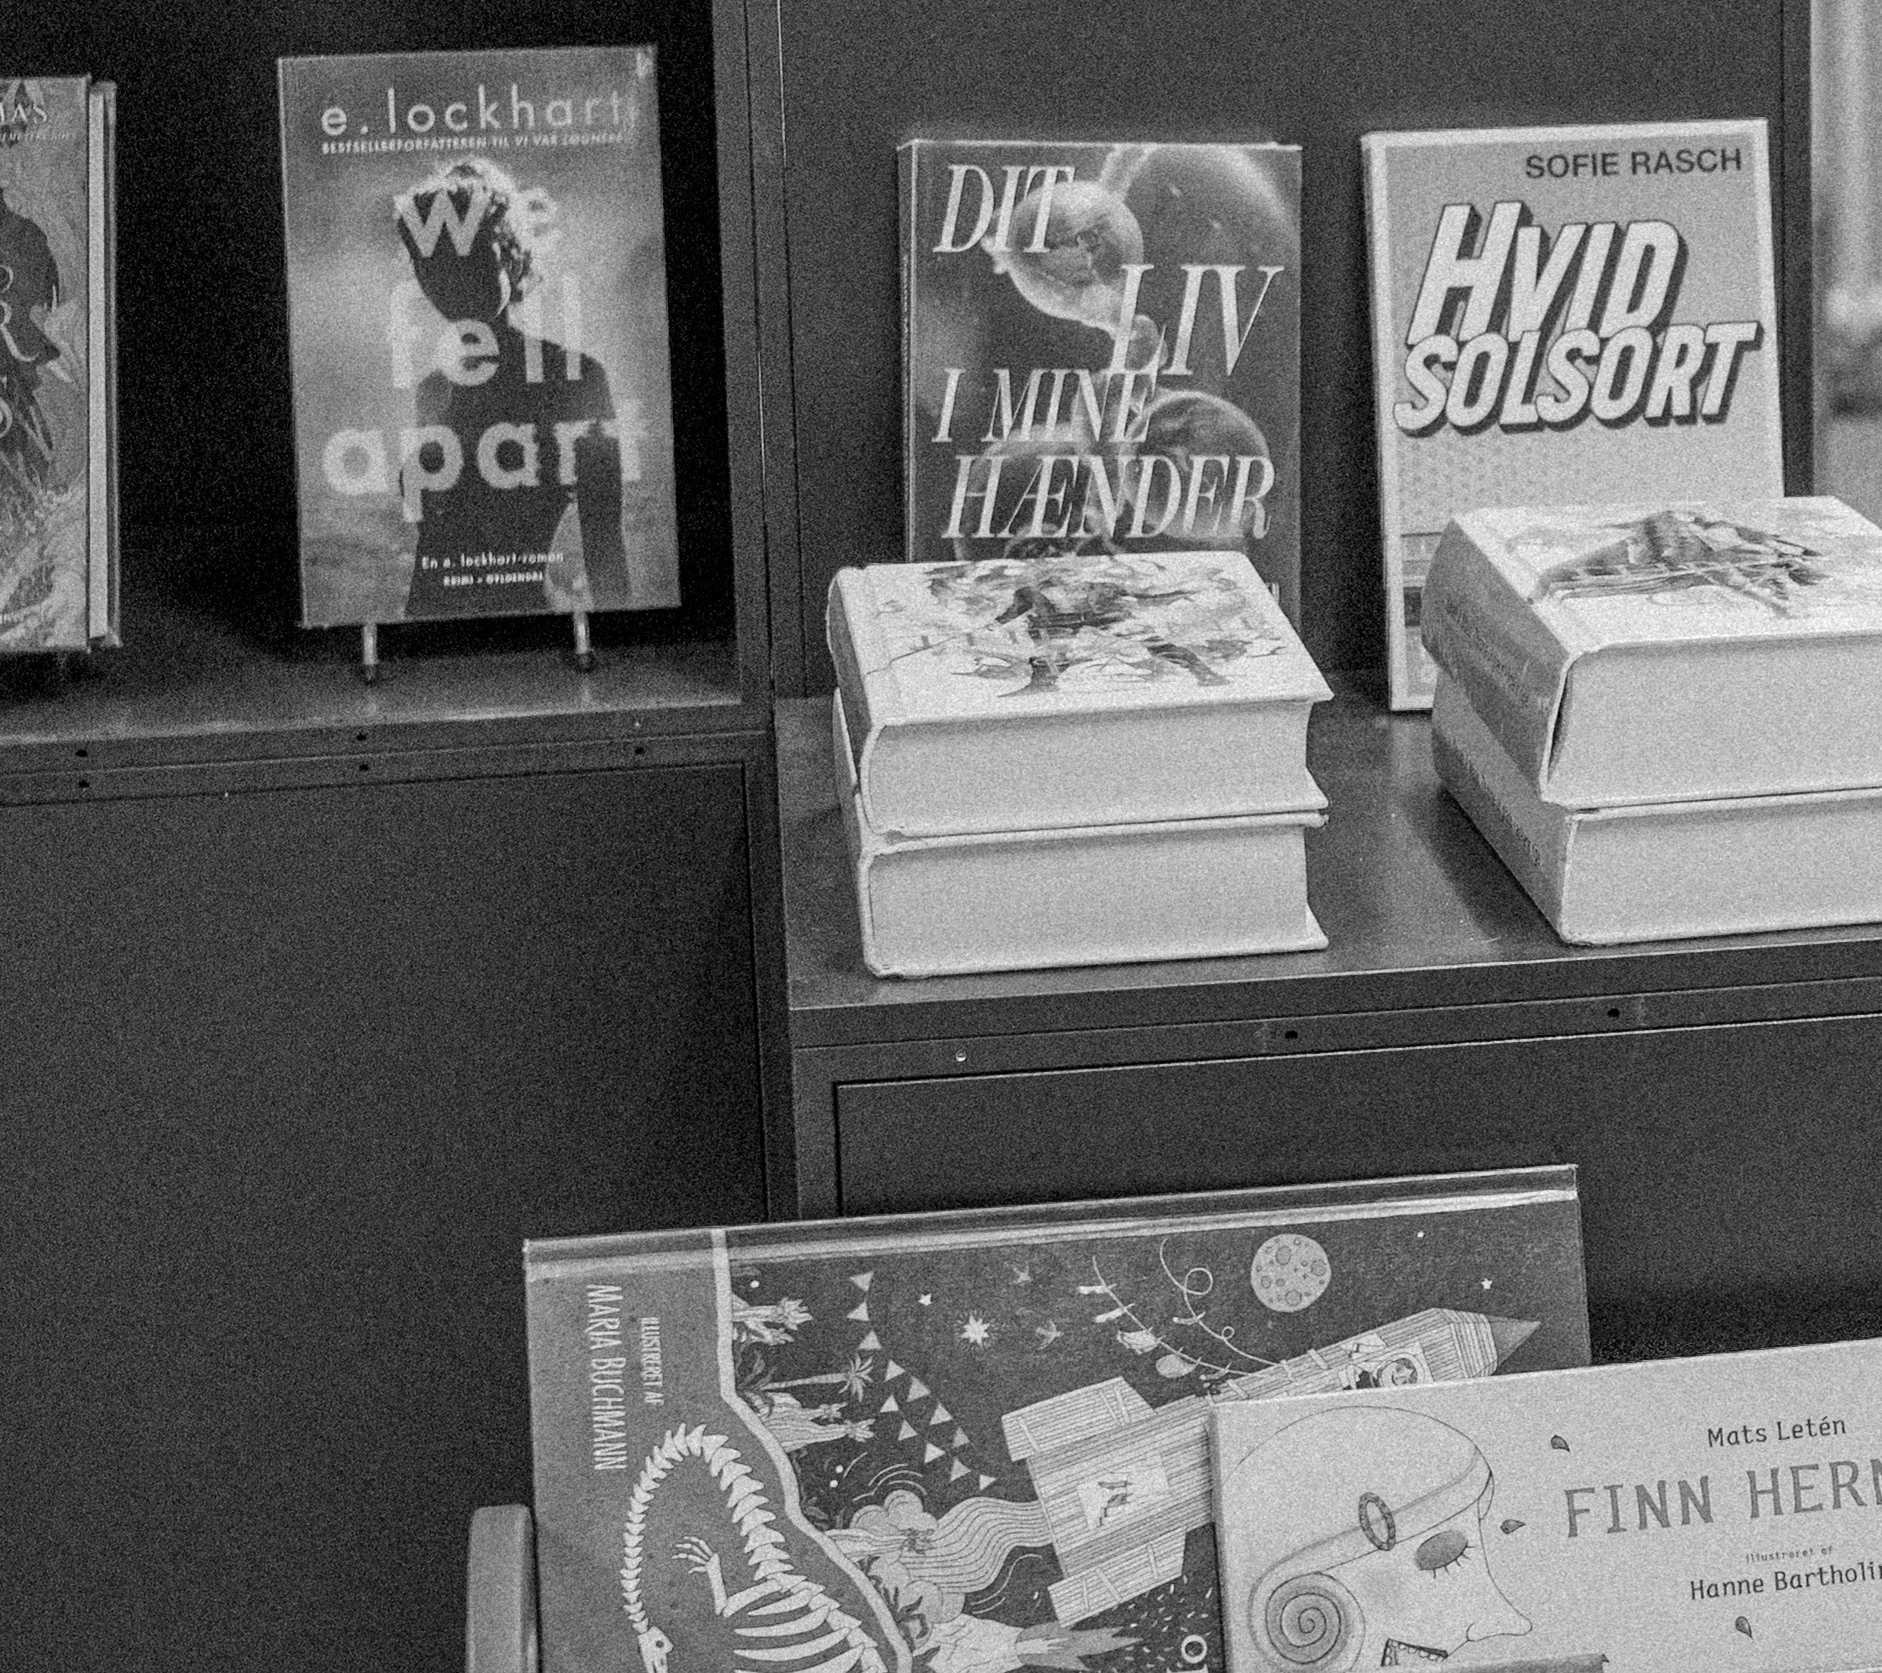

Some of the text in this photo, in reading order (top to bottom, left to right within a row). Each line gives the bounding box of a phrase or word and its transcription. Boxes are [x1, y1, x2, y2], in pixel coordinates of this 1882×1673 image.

[932, 162, 1076, 256] DIT
[1524, 146, 1744, 182] SOFIE RASCH
[394, 186, 557, 258] we
[1407, 200, 1692, 347] HVID
[388, 269, 584, 391] fell
[1104, 265, 1283, 380] LIV
[931, 367, 1158, 445] I MINE
[1392, 319, 1762, 438] SOLSORT
[322, 398, 645, 523] apart
[940, 453, 1277, 541] HÆNDER
[585, 1282, 628, 1472] MARIA BUCHMANN
[1706, 1415, 1847, 1449] Mats Letén
[1562, 1473, 1715, 1539] FINN
[1689, 1574, 1766, 1602] Hanne
